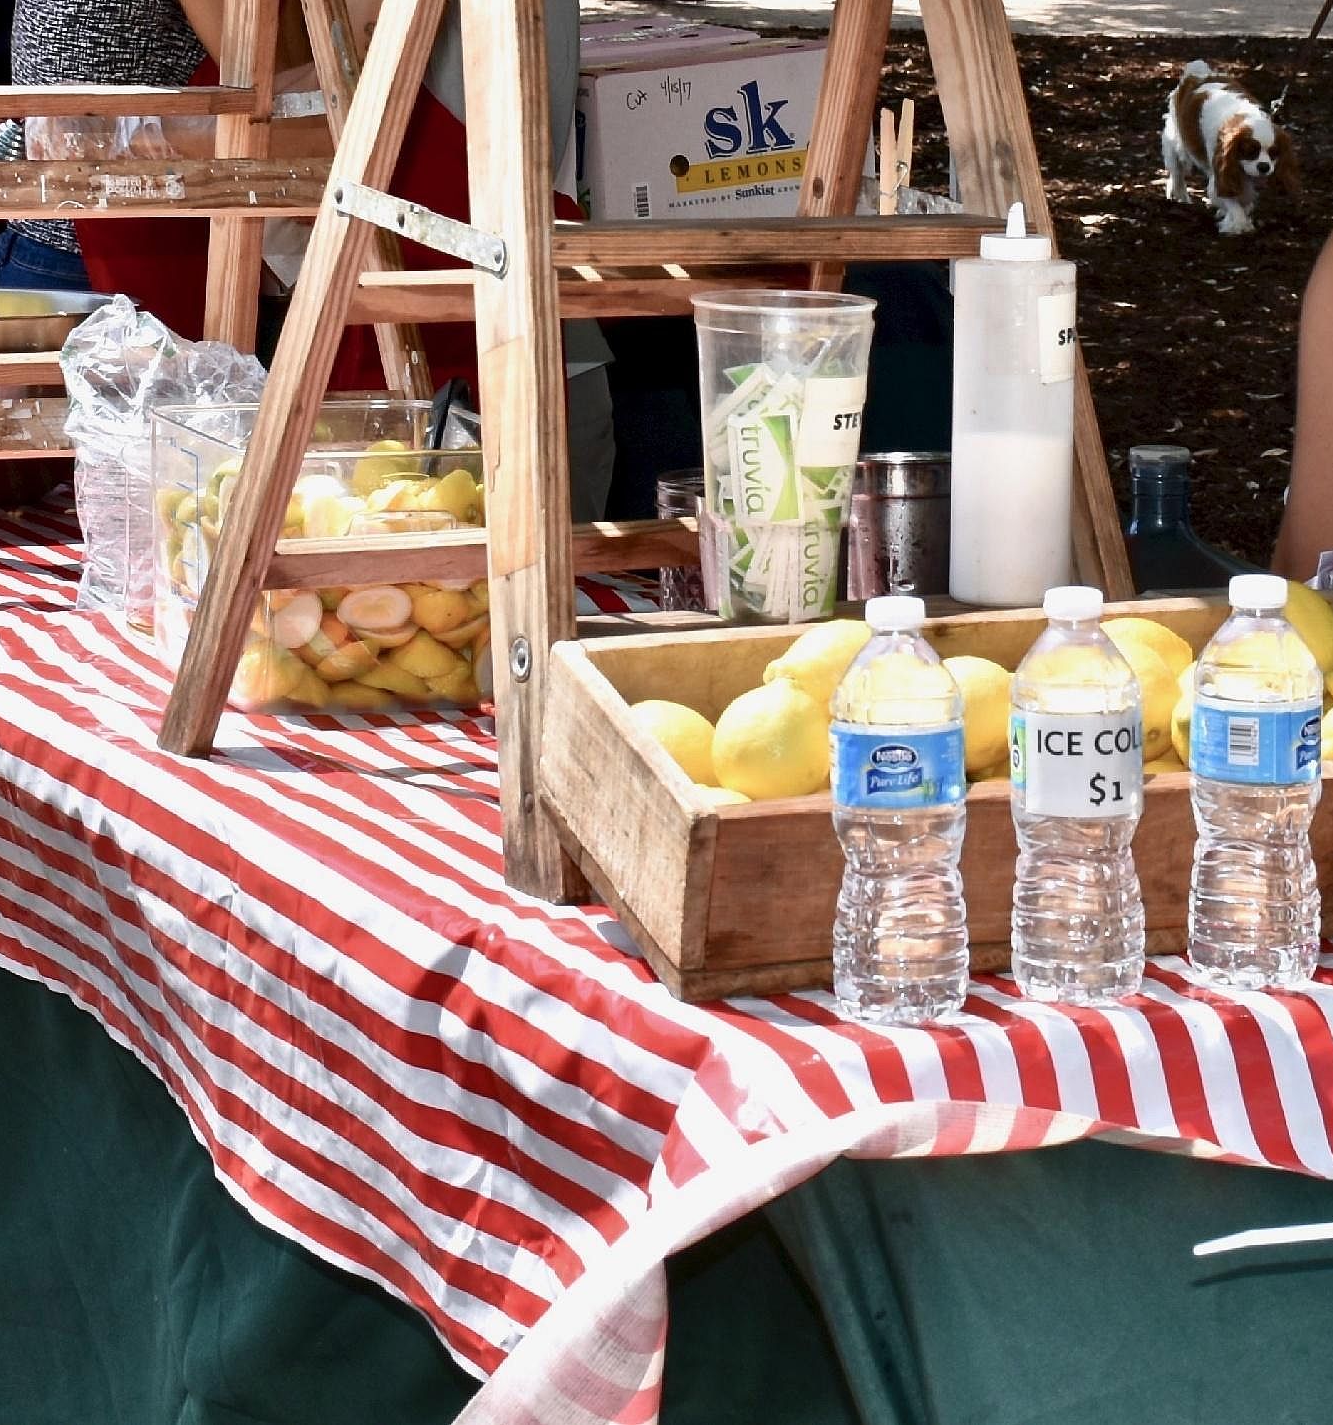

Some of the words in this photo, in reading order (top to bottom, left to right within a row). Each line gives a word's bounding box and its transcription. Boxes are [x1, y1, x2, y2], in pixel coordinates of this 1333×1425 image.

[660, 75, 692, 106] 4/15/17
[704, 80, 796, 159] sk
[704, 156, 802, 184] LEMONS
[668, 196, 717, 208] MARKETED
[735, 184, 775, 200] Sunkist
[1037, 729, 1084, 756] ICE
[1094, 722, 1142, 755] COL
[1089, 771, 1124, 806] $1
